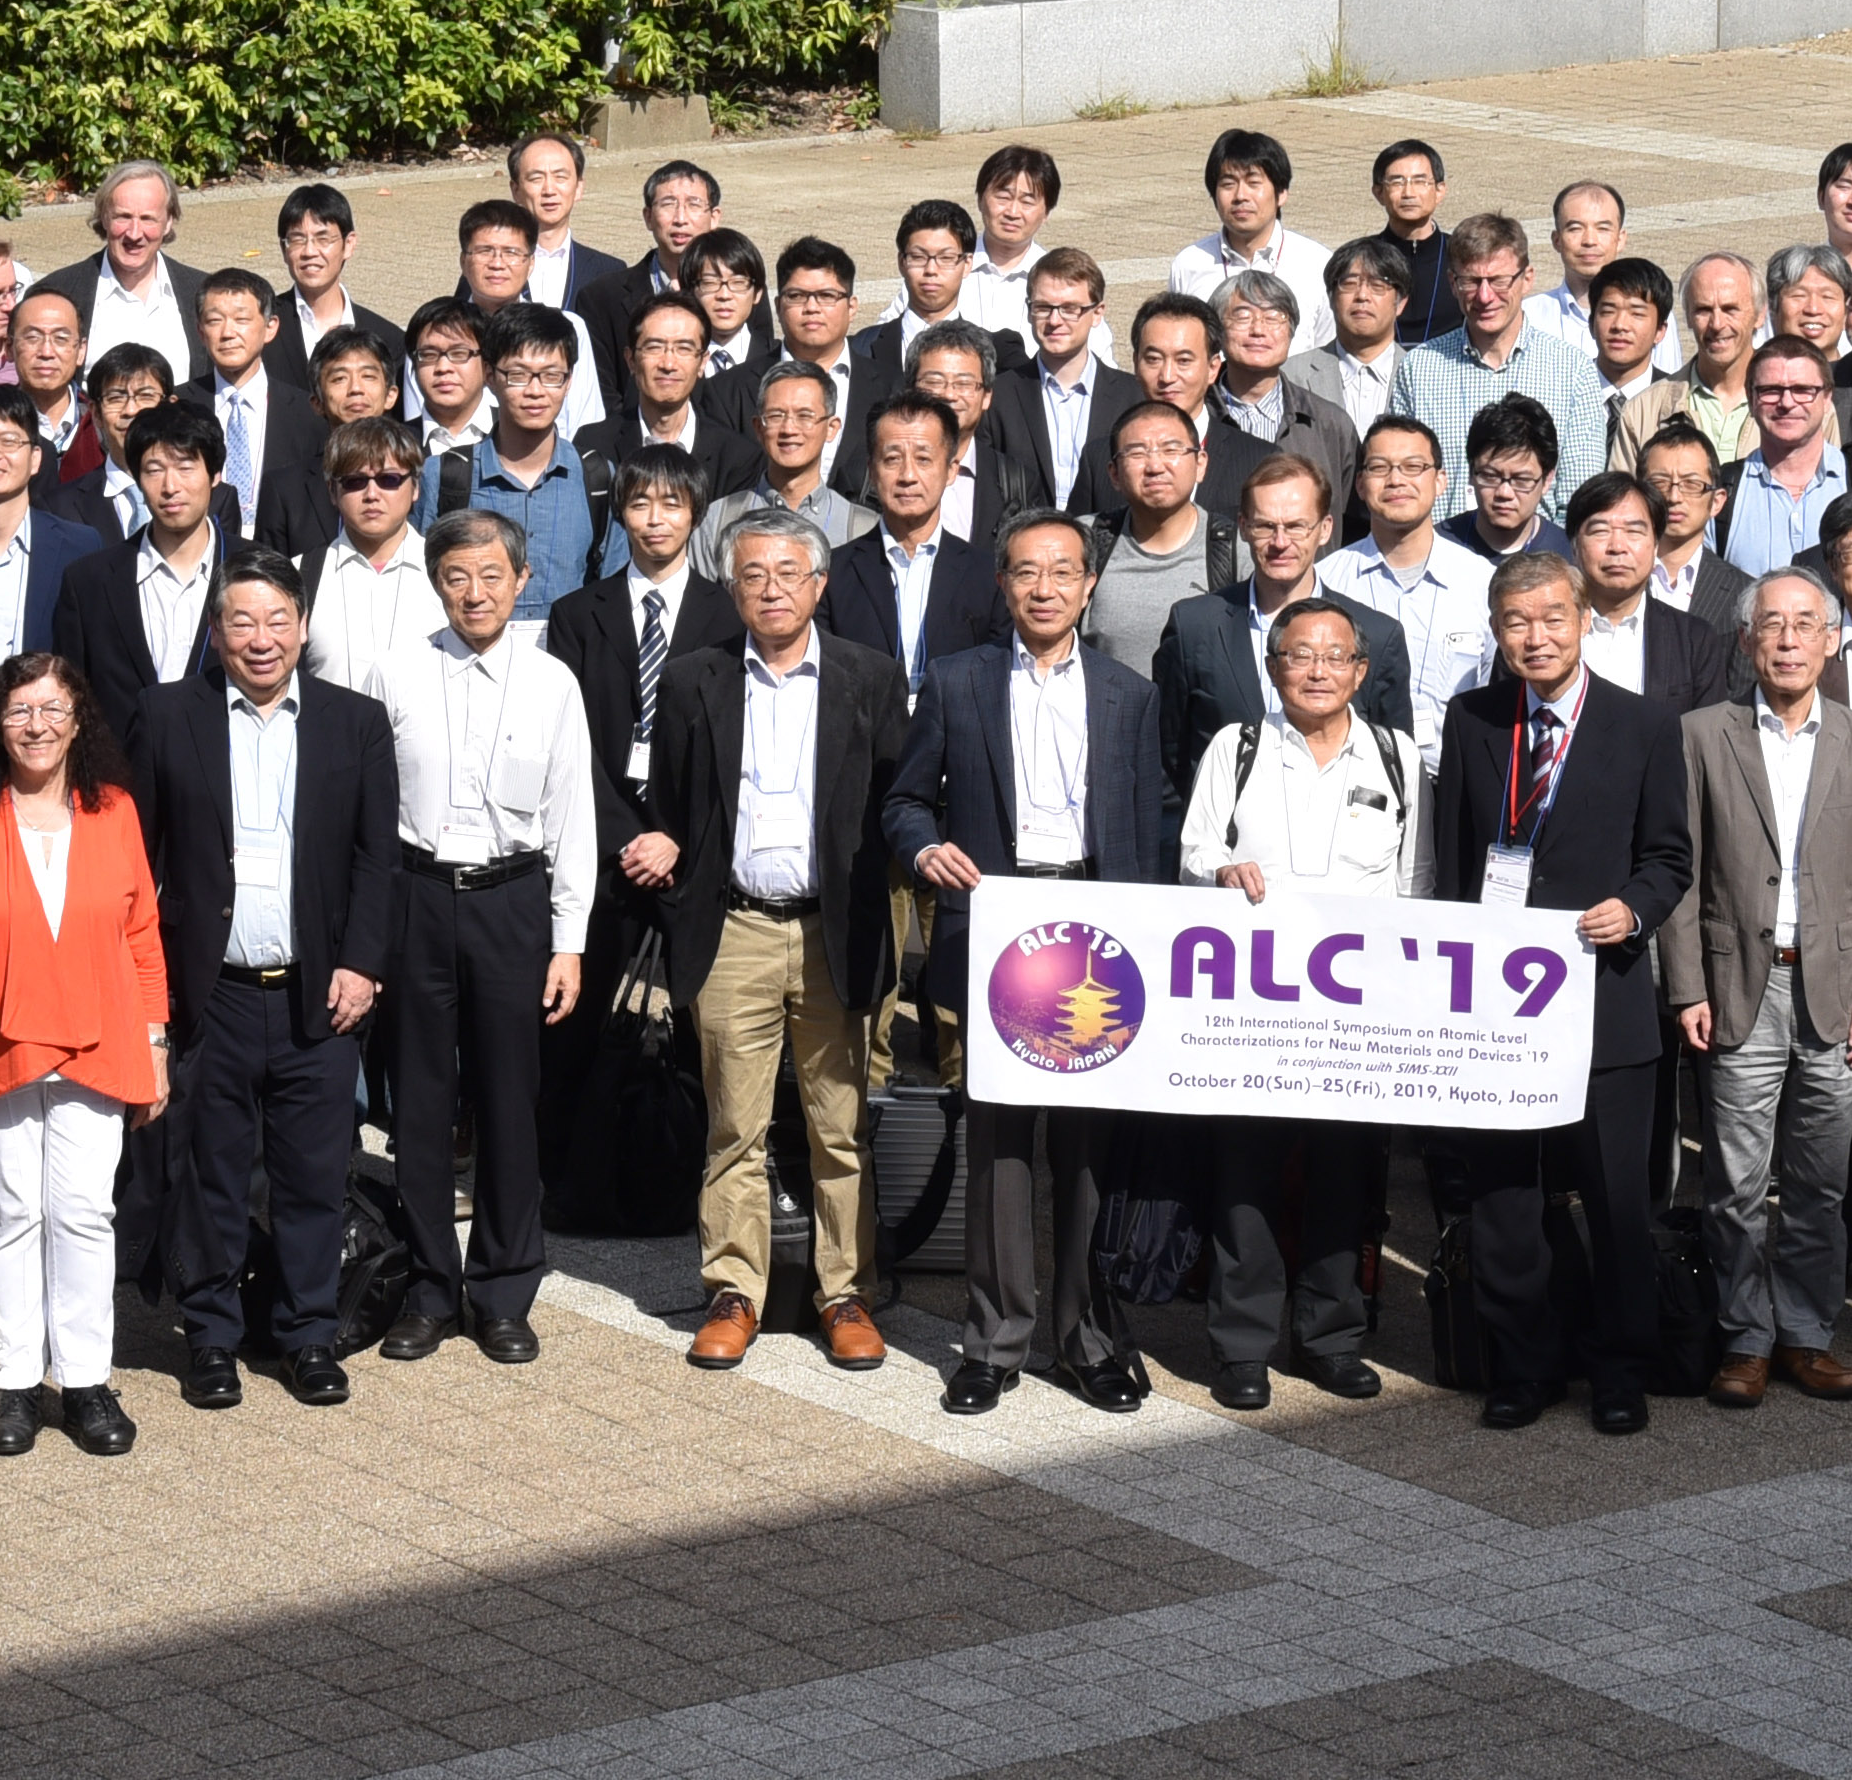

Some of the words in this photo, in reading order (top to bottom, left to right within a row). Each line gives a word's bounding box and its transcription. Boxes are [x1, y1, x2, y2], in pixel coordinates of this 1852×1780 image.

[1017, 922, 1071, 957] ALC
[1083, 925, 1123, 960] '19
[1169, 925, 1365, 1006] ALC
[1399, 936, 1569, 1018] '19
[1205, 1015, 1235, 1028] 12th
[1239, 1016, 1329, 1031] International
[1333, 1019, 1412, 1038] Symposium
[1416, 1029, 1434, 1039] on
[1439, 1027, 1486, 1042] Atomic
[1491, 1030, 1528, 1045] Level
[1011, 1038, 1061, 1072] Kyoto,
[1067, 1043, 1118, 1070] JAPAN
[1180, 1032, 1300, 1048] Characterizations
[1304, 1036, 1324, 1049] for
[1329, 1037, 1362, 1052] New
[1366, 1040, 1432, 1057] Materials
[1436, 1046, 1464, 1059] and
[1468, 1047, 1522, 1063] Devices
[1527, 1050, 1549, 1064] '19
[1276, 1055, 1289, 1067] in
[1292, 1056, 1362, 1071] conjunction
[1365, 1062, 1393, 1074] with
[1395, 1062, 1459, 1078] SIMS-XXII
[1168, 1072, 1237, 1089] October
[1393, 1082, 1442, 1103] 2019,
[1449, 1085, 1502, 1106] Kyoto,
[1508, 1089, 1559, 1108] Japan
